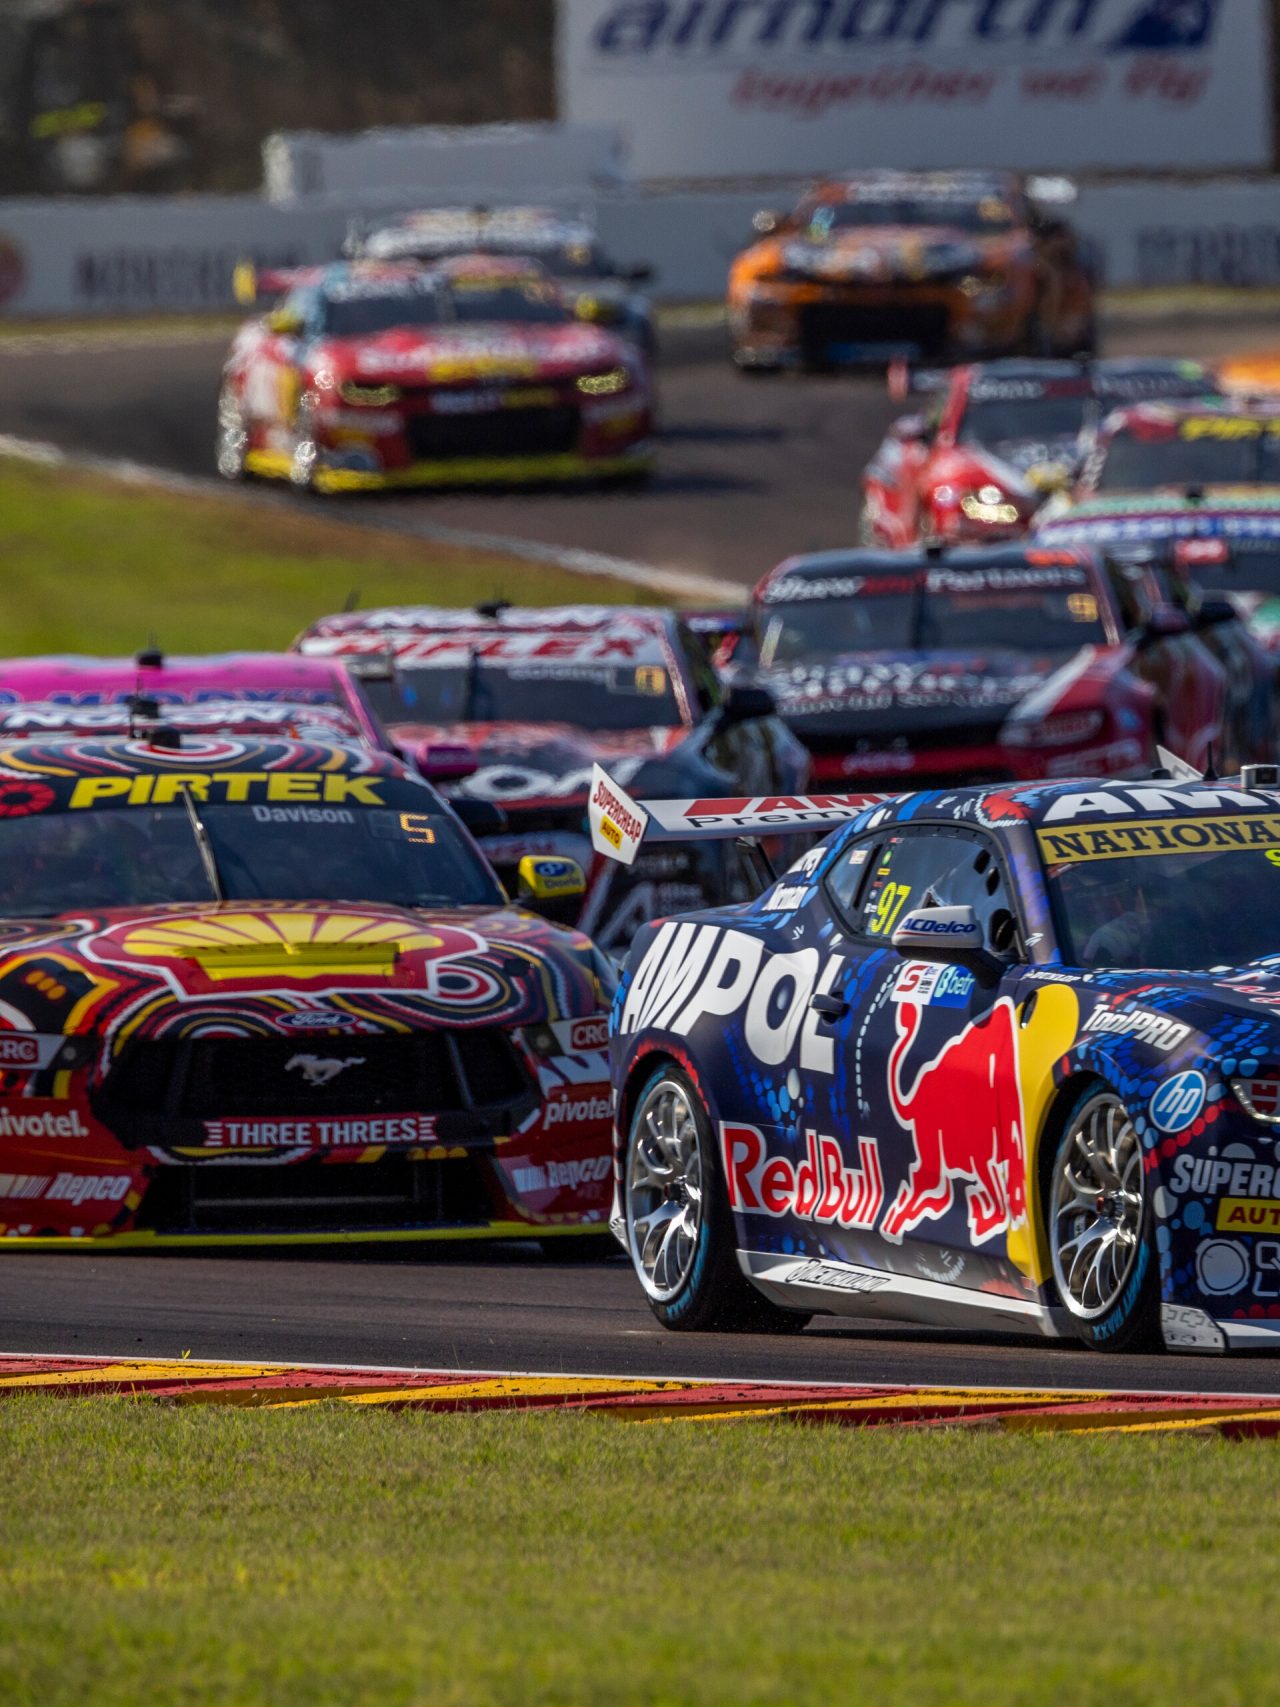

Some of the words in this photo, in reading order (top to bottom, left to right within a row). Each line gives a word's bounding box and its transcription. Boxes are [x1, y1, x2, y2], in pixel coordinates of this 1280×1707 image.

[68, 771, 386, 808] PIRTEK
[253, 804, 354, 825] Davison
[400, 812, 437, 844] 5
[593, 780, 642, 843] SUPERCHEAP
[602, 821, 620, 844] AUTO
[871, 881, 911, 935] 97
[900, 918, 977, 933] ACDelco
[620, 921, 845, 1074] AMPOL
[1082, 1003, 1193, 1051] ToolPRO
[1156, 1070, 1201, 1131] hp
[0, 1107, 90, 1137] ivotel.
[224, 1122, 313, 1145] THREE
[316, 1118, 418, 1144] THREES
[45, 1171, 132, 1206] Repco
[544, 1155, 613, 1191] Repco
[720, 1121, 822, 1224] Red
[816, 1136, 886, 1230] Bull
